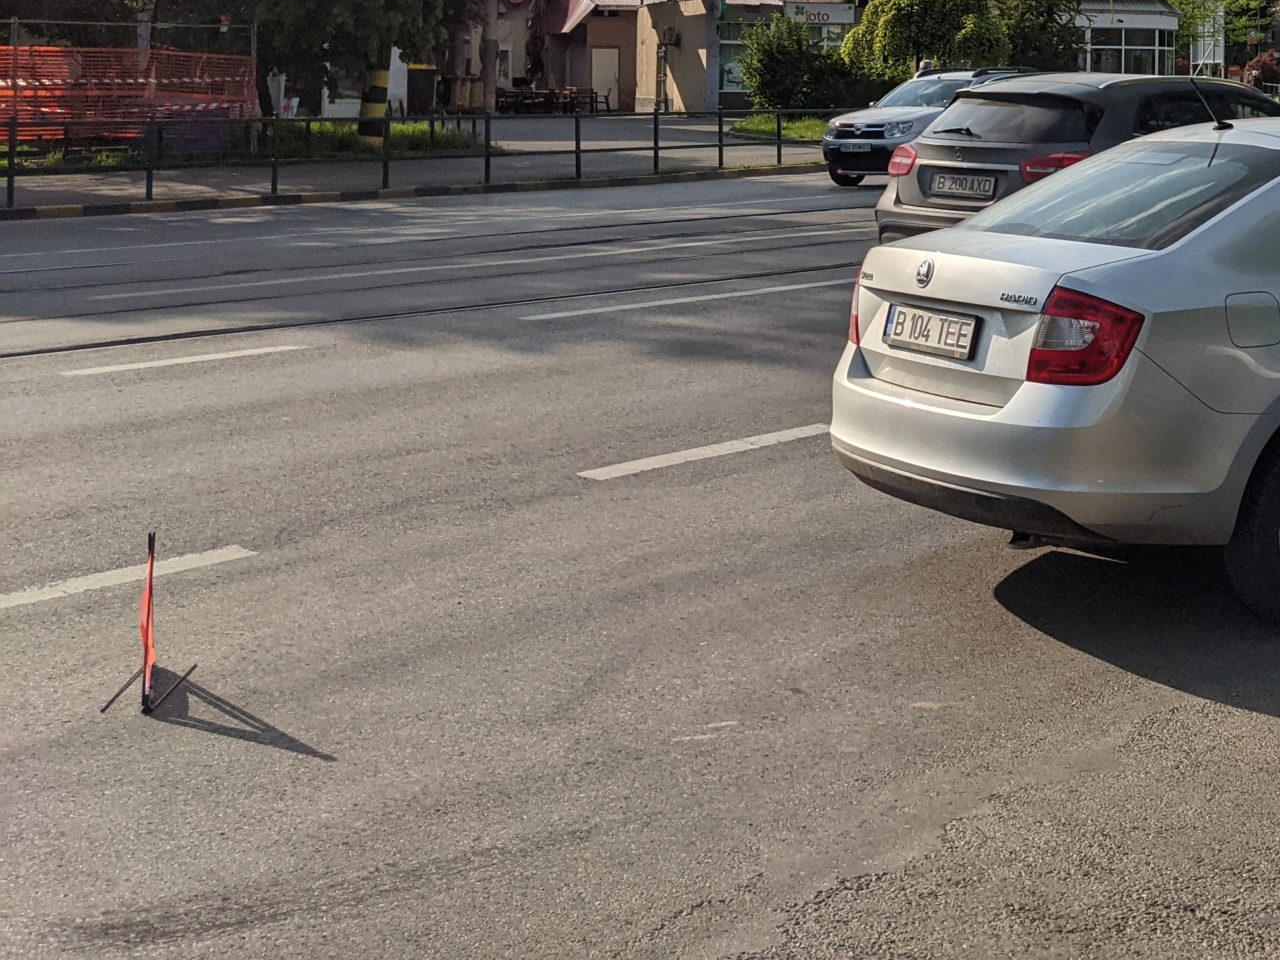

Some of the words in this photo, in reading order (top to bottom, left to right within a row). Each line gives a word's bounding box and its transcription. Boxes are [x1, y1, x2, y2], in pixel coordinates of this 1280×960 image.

[936, 175, 946, 190] B
[968, 177, 992, 193] AXD
[1000, 292, 1038, 306] RAPID
[894, 310, 906, 337] B
[909, 313, 931, 343] 104
[938, 317, 972, 350] TEE
